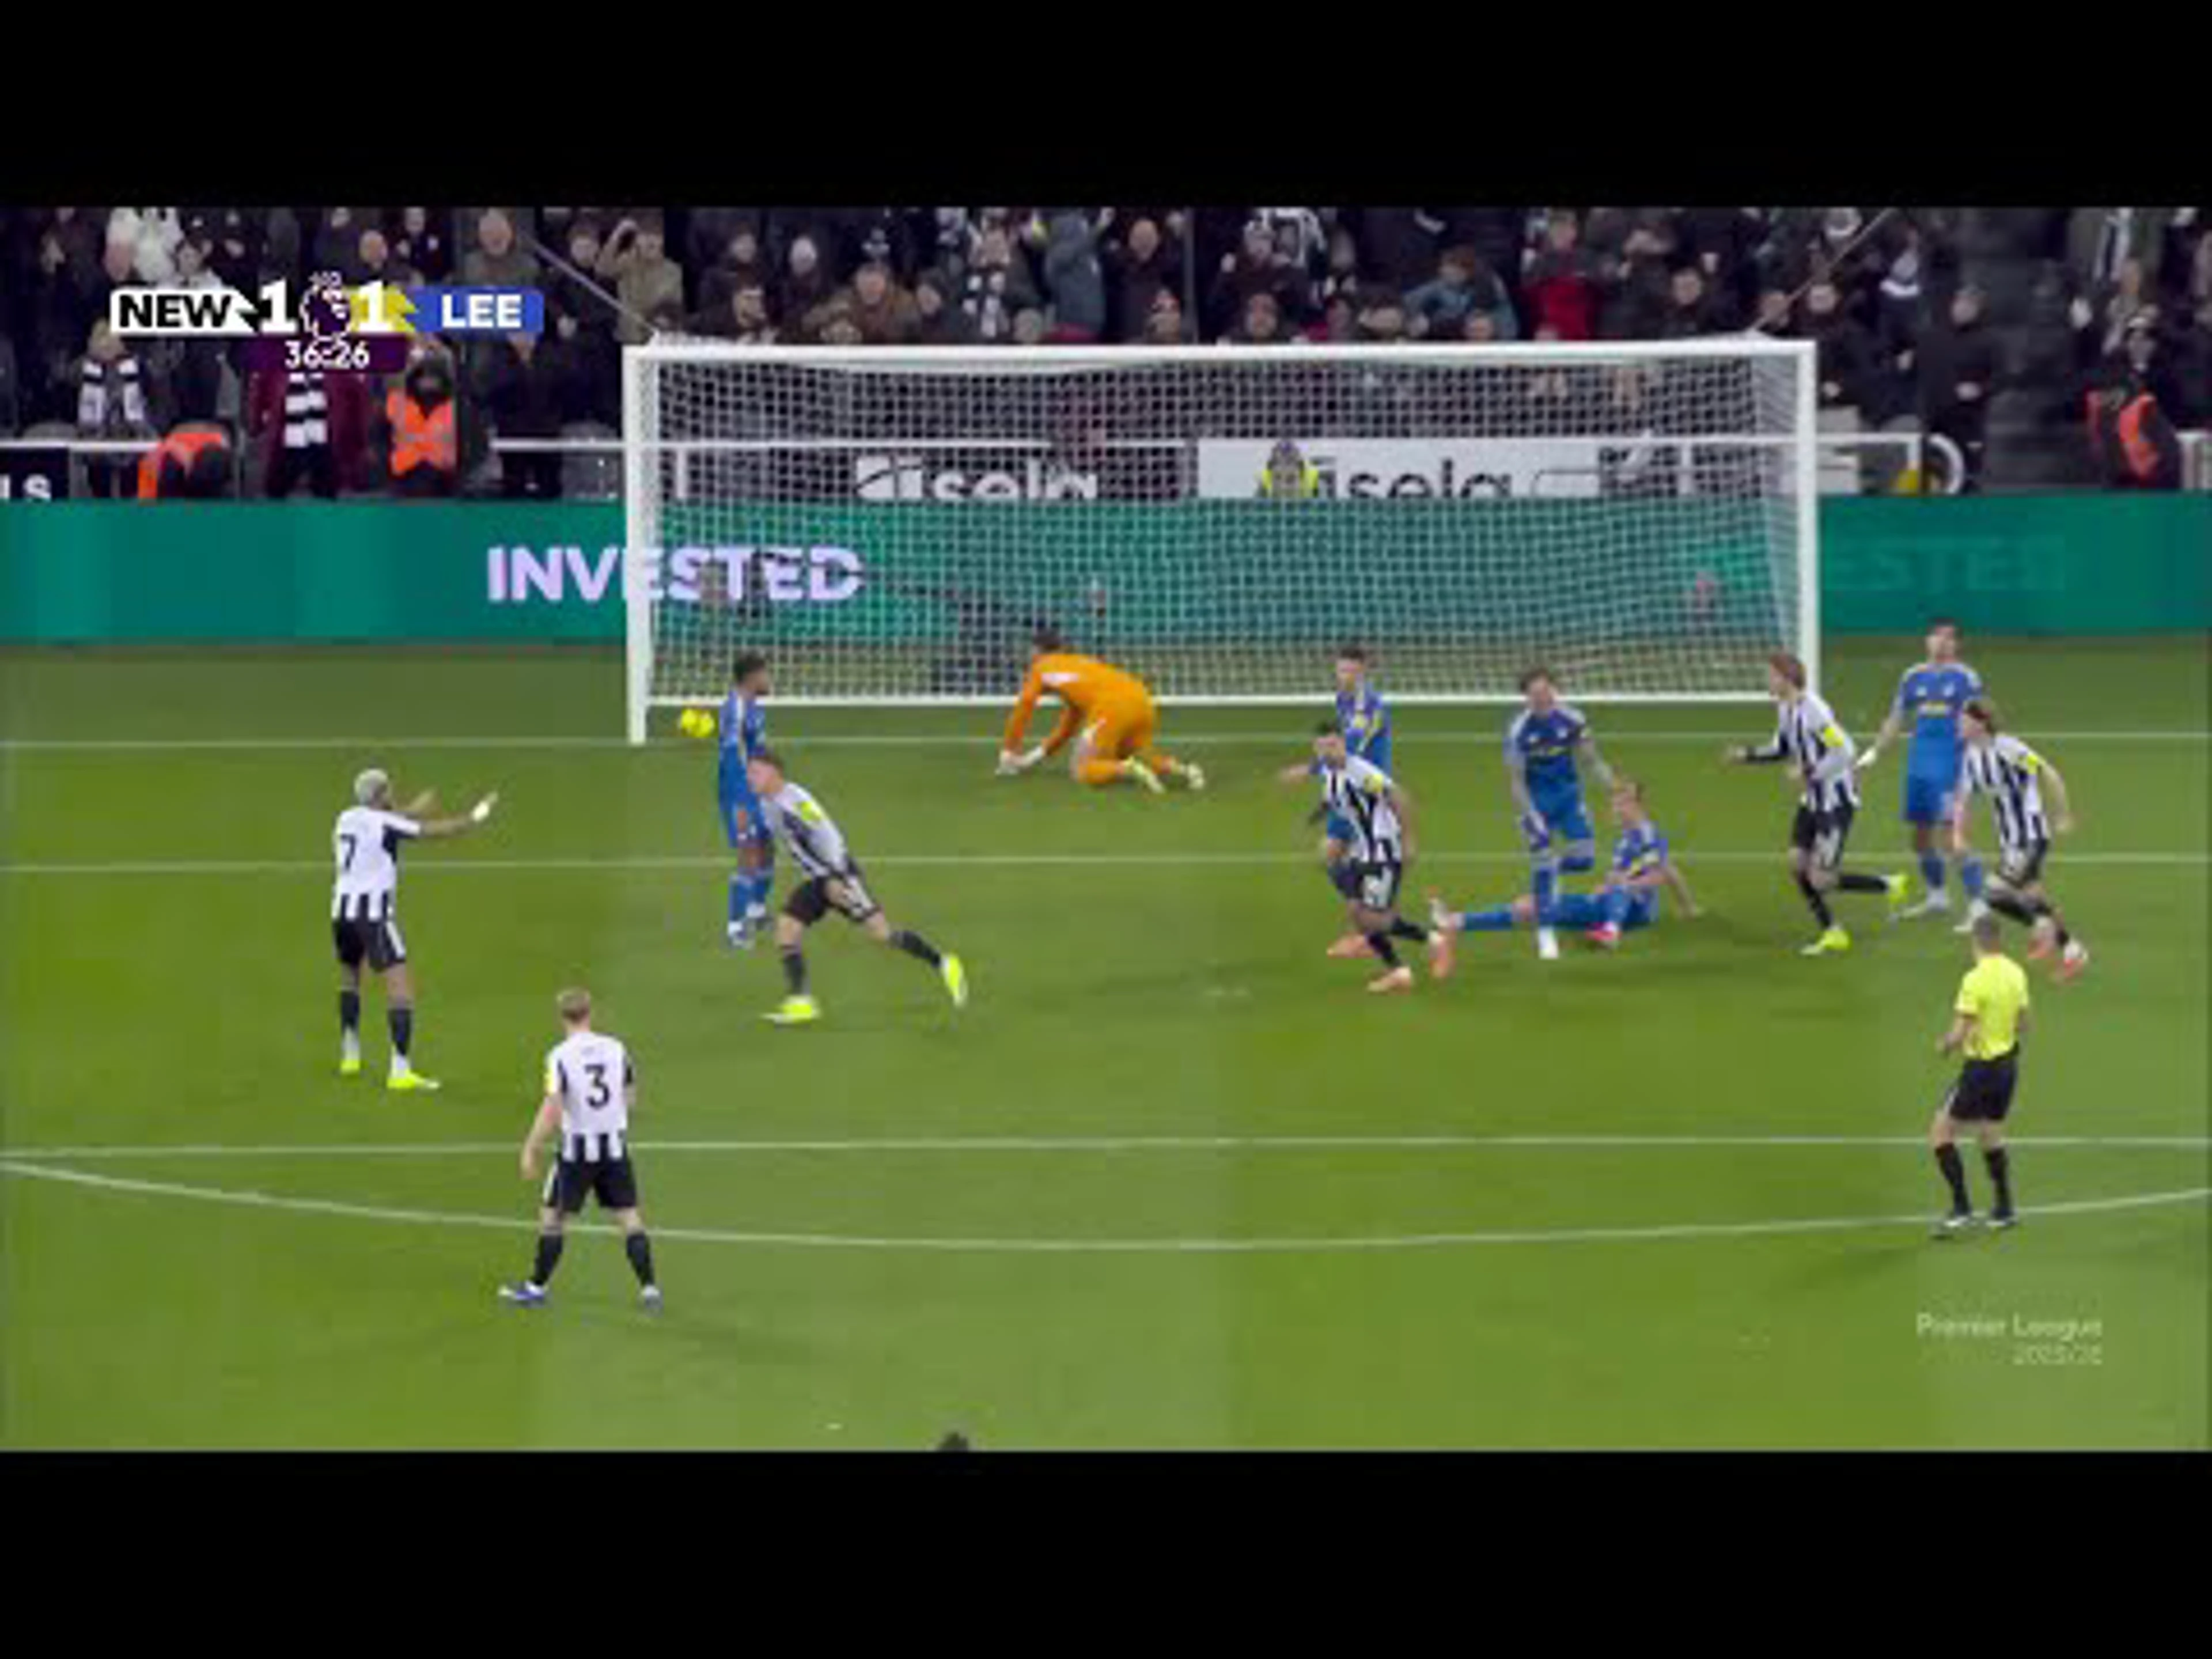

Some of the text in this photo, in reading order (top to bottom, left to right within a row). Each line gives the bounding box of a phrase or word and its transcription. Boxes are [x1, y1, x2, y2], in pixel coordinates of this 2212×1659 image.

[487, 546, 864, 601] INVESTED
[340, 834, 357, 871] 7
[584, 1063, 610, 1111] 3
